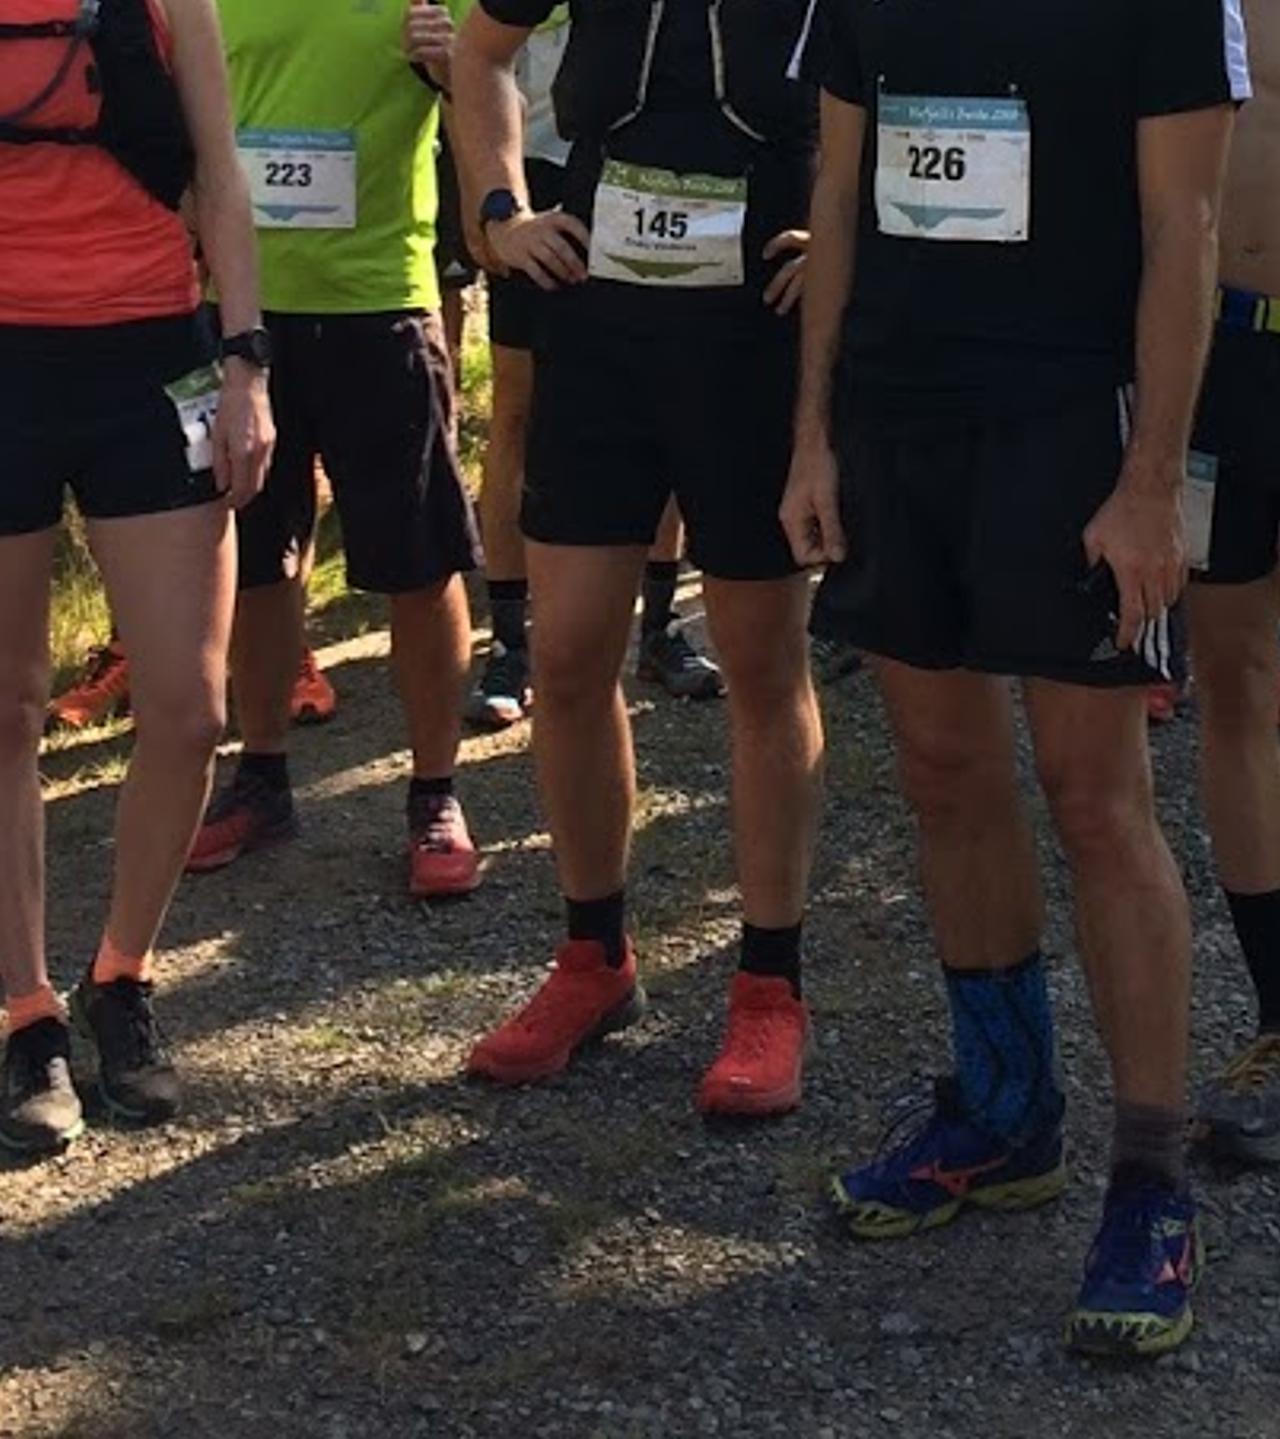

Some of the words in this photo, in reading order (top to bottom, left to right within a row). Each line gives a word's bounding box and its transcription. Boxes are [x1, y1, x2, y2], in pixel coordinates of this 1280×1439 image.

[265, 161, 312, 188] 223
[907, 144, 966, 181] 226
[634, 207, 689, 239] 145
